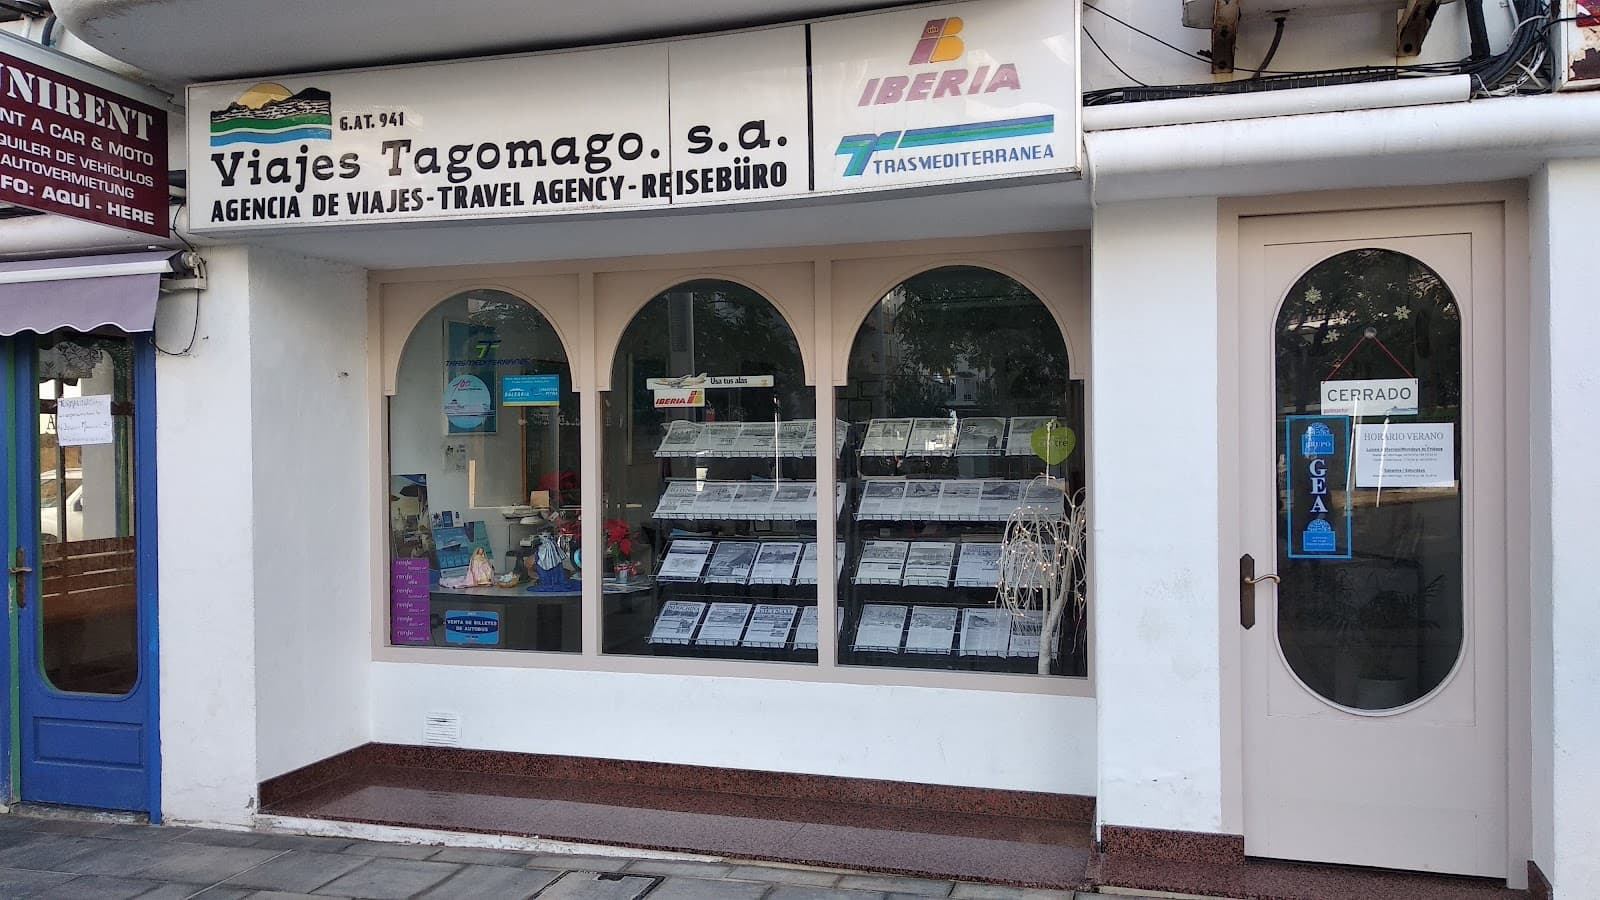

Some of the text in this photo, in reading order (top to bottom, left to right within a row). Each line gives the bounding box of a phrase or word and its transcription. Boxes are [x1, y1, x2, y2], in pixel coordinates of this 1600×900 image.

[0, 63, 153, 142] NIRENT
[858, 63, 1021, 107] IBERIA
[379, 112, 404, 128] 941
[31, 118, 45, 134] A
[50, 123, 86, 146] CAR
[91, 136, 103, 151] &
[108, 141, 154, 166] MOTO
[210, 144, 361, 193] Viajes
[687, 119, 787, 154] s.a.
[873, 144, 1054, 175] TRASMEDITERRANEA
[1, 153, 135, 199] AUTOVERMIETUNG
[55, 149, 76, 166] DE
[79, 155, 154, 188] VEHÍCULOS
[41, 186, 91, 210] AQUÍ
[107, 201, 155, 226] HERE
[210, 195, 301, 223] AGENCIA
[312, 192, 339, 217] DE
[710, 377, 722, 385] Usa
[1327, 387, 1411, 402] CERRADO
[1364, 431, 1444, 441] HORARIO VERANO
[1309, 458, 1328, 513] GEA
